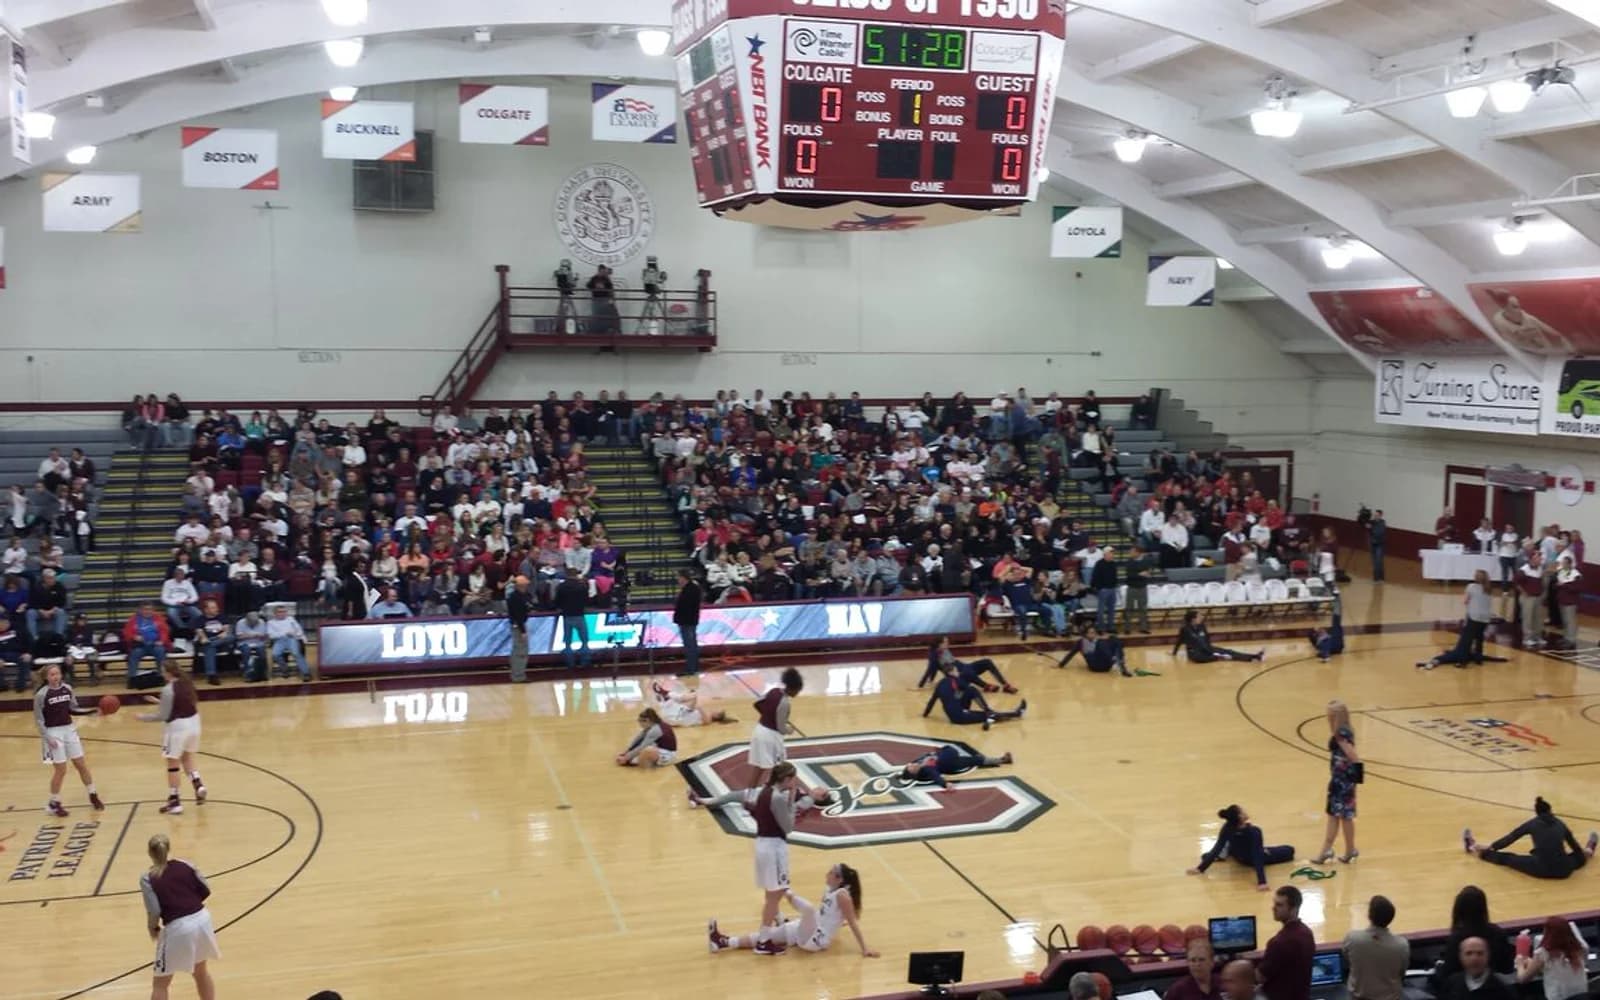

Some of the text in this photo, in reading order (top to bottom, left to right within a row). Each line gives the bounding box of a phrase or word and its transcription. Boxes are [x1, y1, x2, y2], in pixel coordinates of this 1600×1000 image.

[819, 30, 842, 39] Time
[819, 39, 853, 49] Warner
[865, 28, 964, 68] 51:28
[818, 48, 845, 57] Cable
[784, 64, 853, 84] COLGATE
[890, 79, 934, 91] PERIOD
[975, 75, 1035, 92] GUEST
[856, 92, 886, 103] POSS
[936, 95, 965, 107] POSS
[748, 52, 772, 168] NBT BANK
[821, 87, 842, 122] 0
[913, 93, 921, 125] 1
[478, 108, 532, 120] COLGATE
[855, 111, 891, 123] BONUS
[1006, 97, 1026, 130] 0
[929, 114, 964, 126] BONUS
[336, 123, 400, 136] BUCKNELL
[783, 124, 823, 136] FOULS
[878, 128, 960, 143] PLAYER FOUL
[991, 133, 1029, 145] FOULS
[203, 151, 259, 164] BOSTON
[796, 139, 817, 174] 0
[1002, 148, 1023, 181] 0
[783, 177, 814, 188] WON
[910, 181, 945, 192] GAME
[991, 184, 1021, 194] WON
[73, 195, 112, 207] ARMY
[1067, 227, 1106, 236] LOYOLA
[1408, 361, 1541, 403] Turning Stone
[381, 624, 467, 657] LOYO
[8, 824, 65, 882] PATRIOT
[46, 821, 101, 878] LEAGUE
